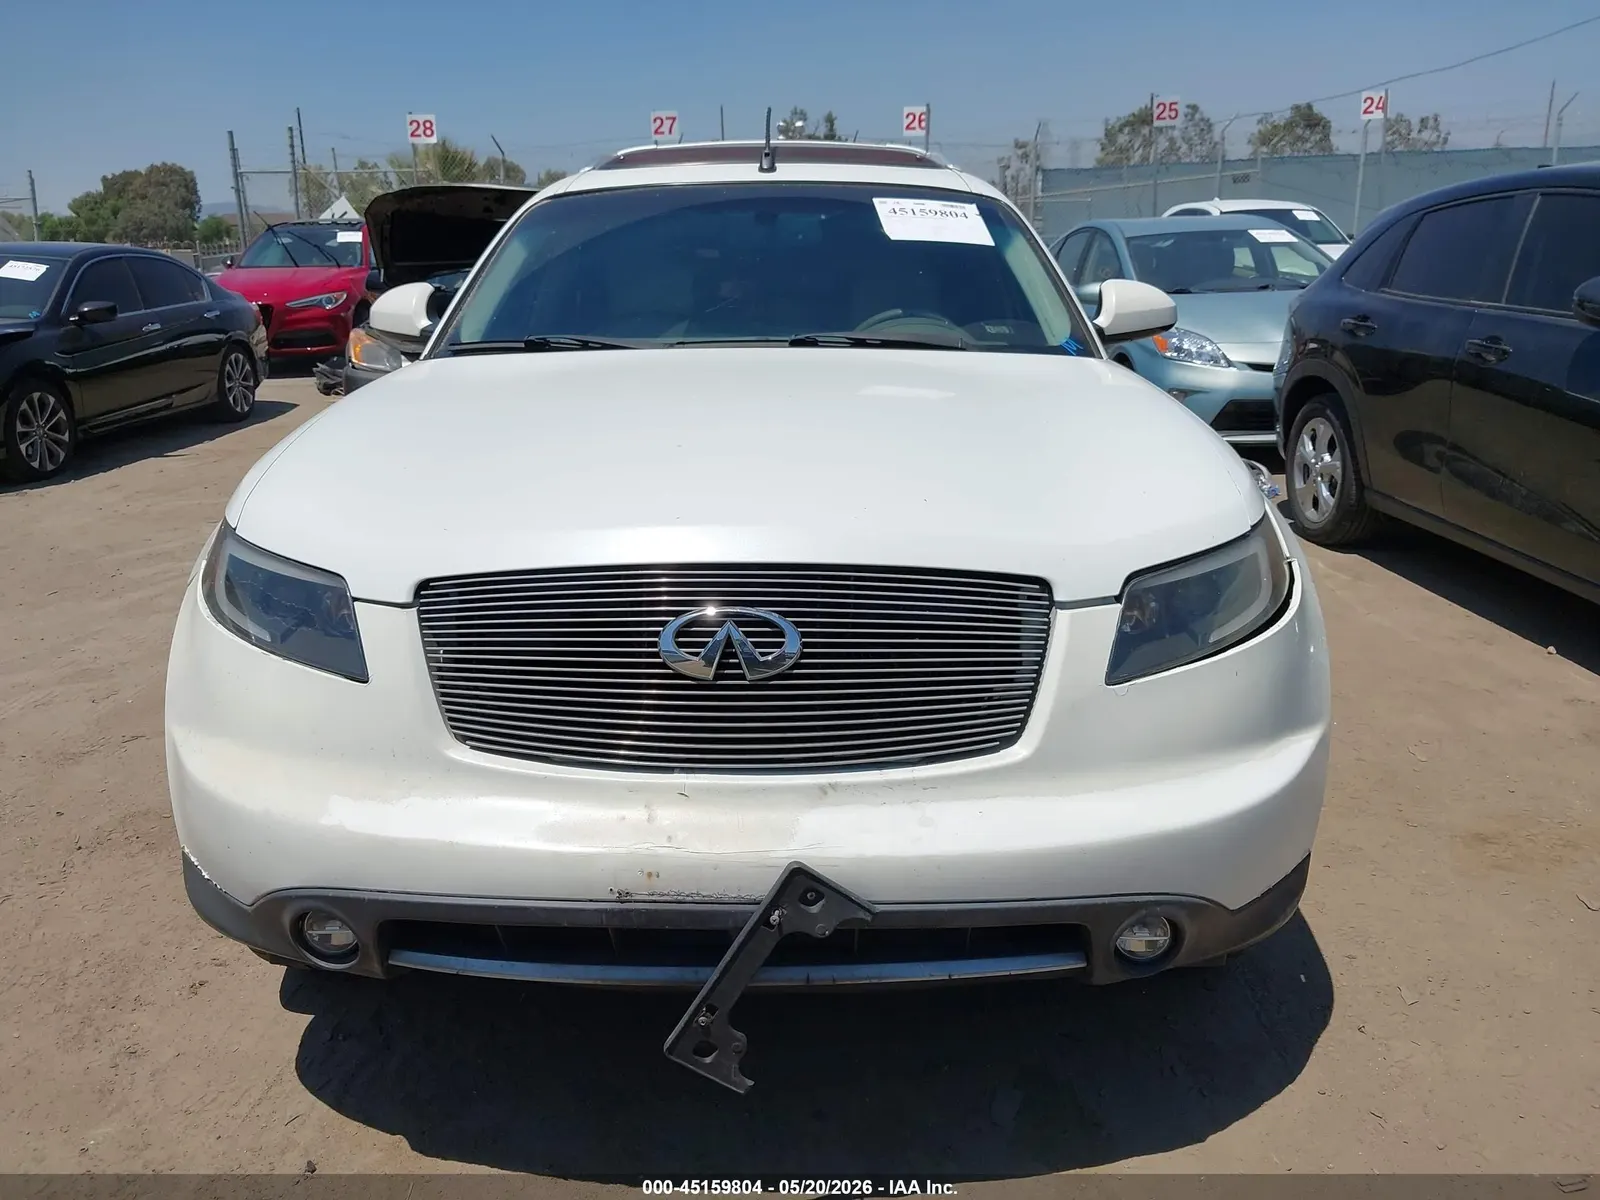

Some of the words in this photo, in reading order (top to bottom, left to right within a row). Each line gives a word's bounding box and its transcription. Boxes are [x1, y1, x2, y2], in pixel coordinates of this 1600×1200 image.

[1155, 101, 1179, 121] 25
[1362, 95, 1385, 115] 24
[409, 119, 435, 138] 28
[653, 115, 677, 136] 27
[888, 207, 968, 219] 45159804
